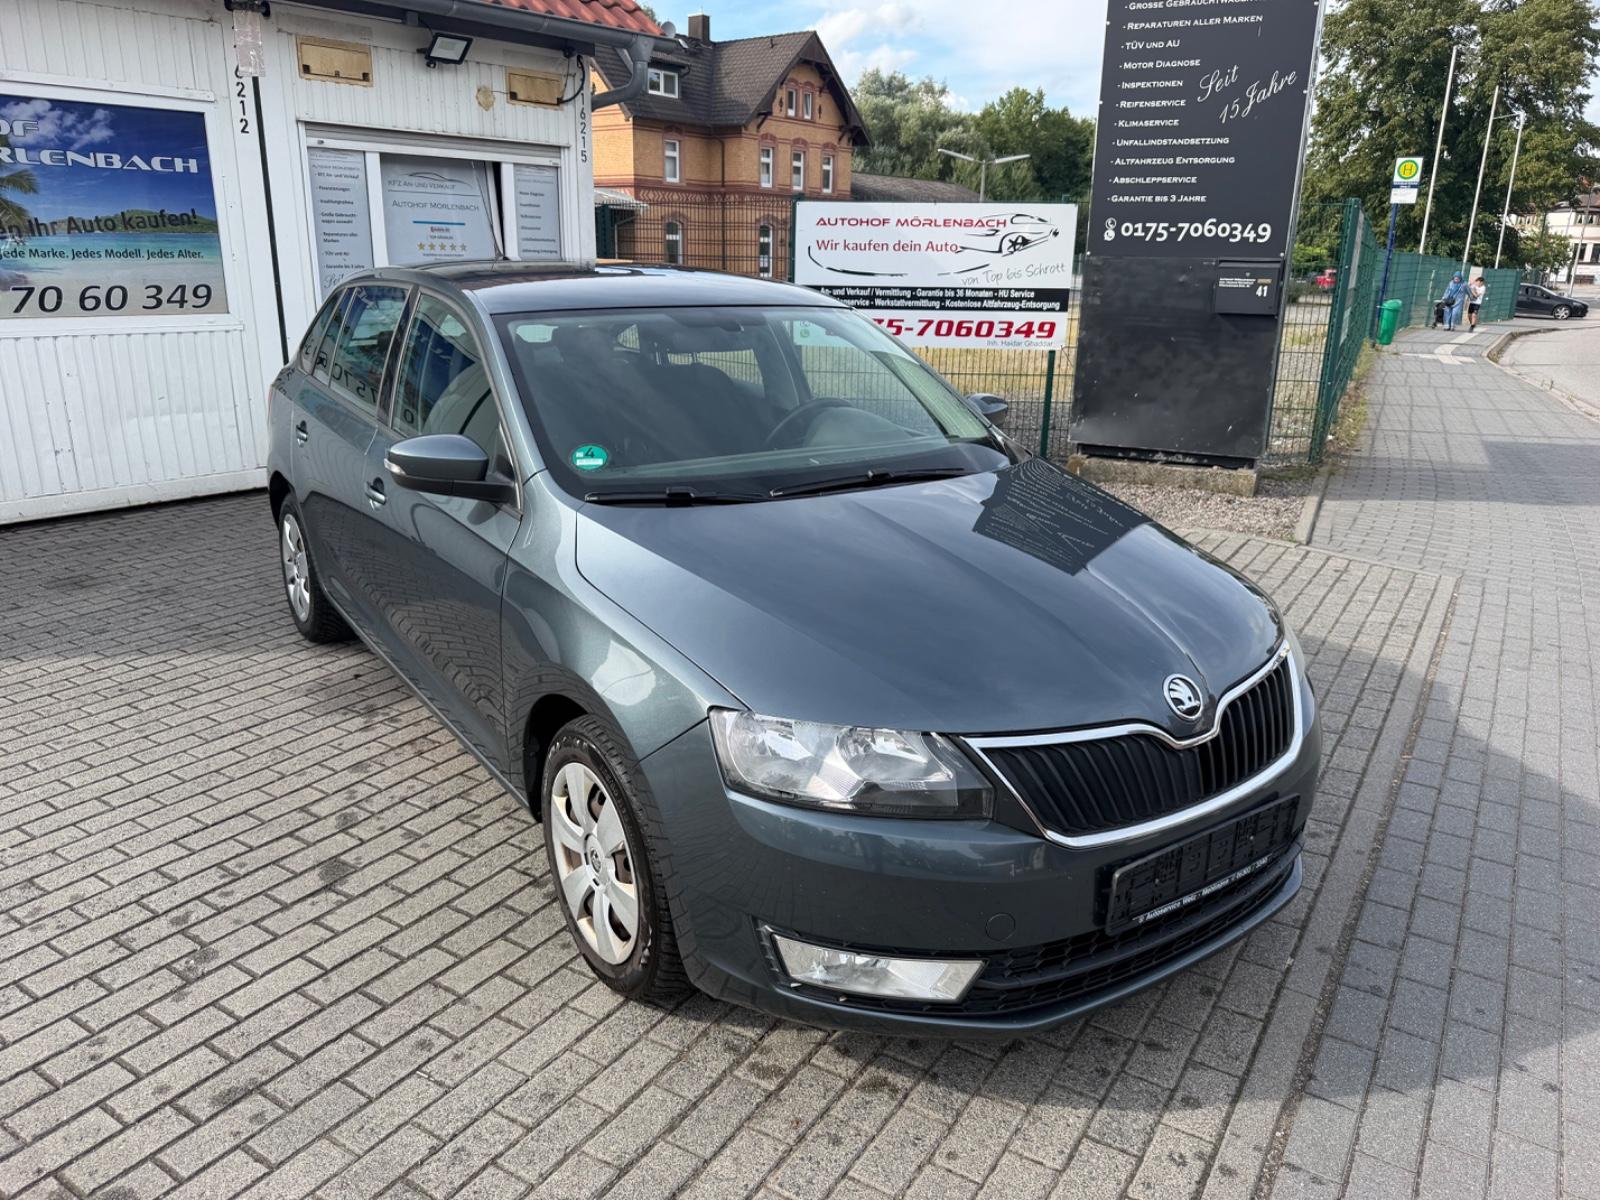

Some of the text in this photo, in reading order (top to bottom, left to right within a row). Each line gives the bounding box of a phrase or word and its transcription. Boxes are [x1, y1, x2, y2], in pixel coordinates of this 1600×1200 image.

[1128, 1, 1164, 10] GROSSE
[1126, 14, 1264, 30] REPARATUREN ALLER MARKEN
[1125, 39, 1181, 50] TÜV UND AU
[1123, 58, 1201, 70] MOTOR DIAGNOSE
[1121, 79, 1184, 89] INSPEKTIONEN
[1197, 64, 1239, 102] Seit
[1218, 69, 1298, 124] 15 Jahre
[1119, 99, 1187, 109] REIFENSERVICE
[1118, 118, 1180, 128] KLIMASERVICE
[1114, 156, 1236, 166] ALTFAHRZEUG ENTSORGUNG
[1403, 163, 1414, 176] H
[1112, 176, 1198, 185] ABSCHLEPPSERVICE
[1111, 194, 1207, 203] GARANTIE BIS 3 JAHRE
[27, 216, 58, 237] Ihr
[66, 213, 117, 235] Auto
[121, 208, 197, 231] kaufen!
[815, 215, 1007, 229] AUTOHOF MÖRLENBACH
[1120, 218, 1272, 243] 0175-7060349
[815, 239, 958, 253] Wir kaufen dein Auto
[28, 248, 69, 259] Marke.
[71, 248, 101, 260] Jedes
[104, 248, 145, 260] Modell.
[147, 248, 175, 260] Jedes
[177, 248, 204, 260] Alter.
[961, 261, 1065, 286] von Top bis Schrott
[832, 288, 846, 296] und
[846, 287, 871, 296] Verkauf
[875, 288, 912, 298] Vermittlung
[916, 288, 943, 297] Garantie
[944, 289, 955, 297] bis
[965, 289, 994, 298] Monaten
[998, 290, 1009, 298] HU
[1010, 290, 1035, 298] Service
[1256, 285, 1268, 297] 41
[11, 283, 213, 314] 70 60 349
[945, 299, 981, 308] Kostenlose
[584, 447, 595, 458] 4
